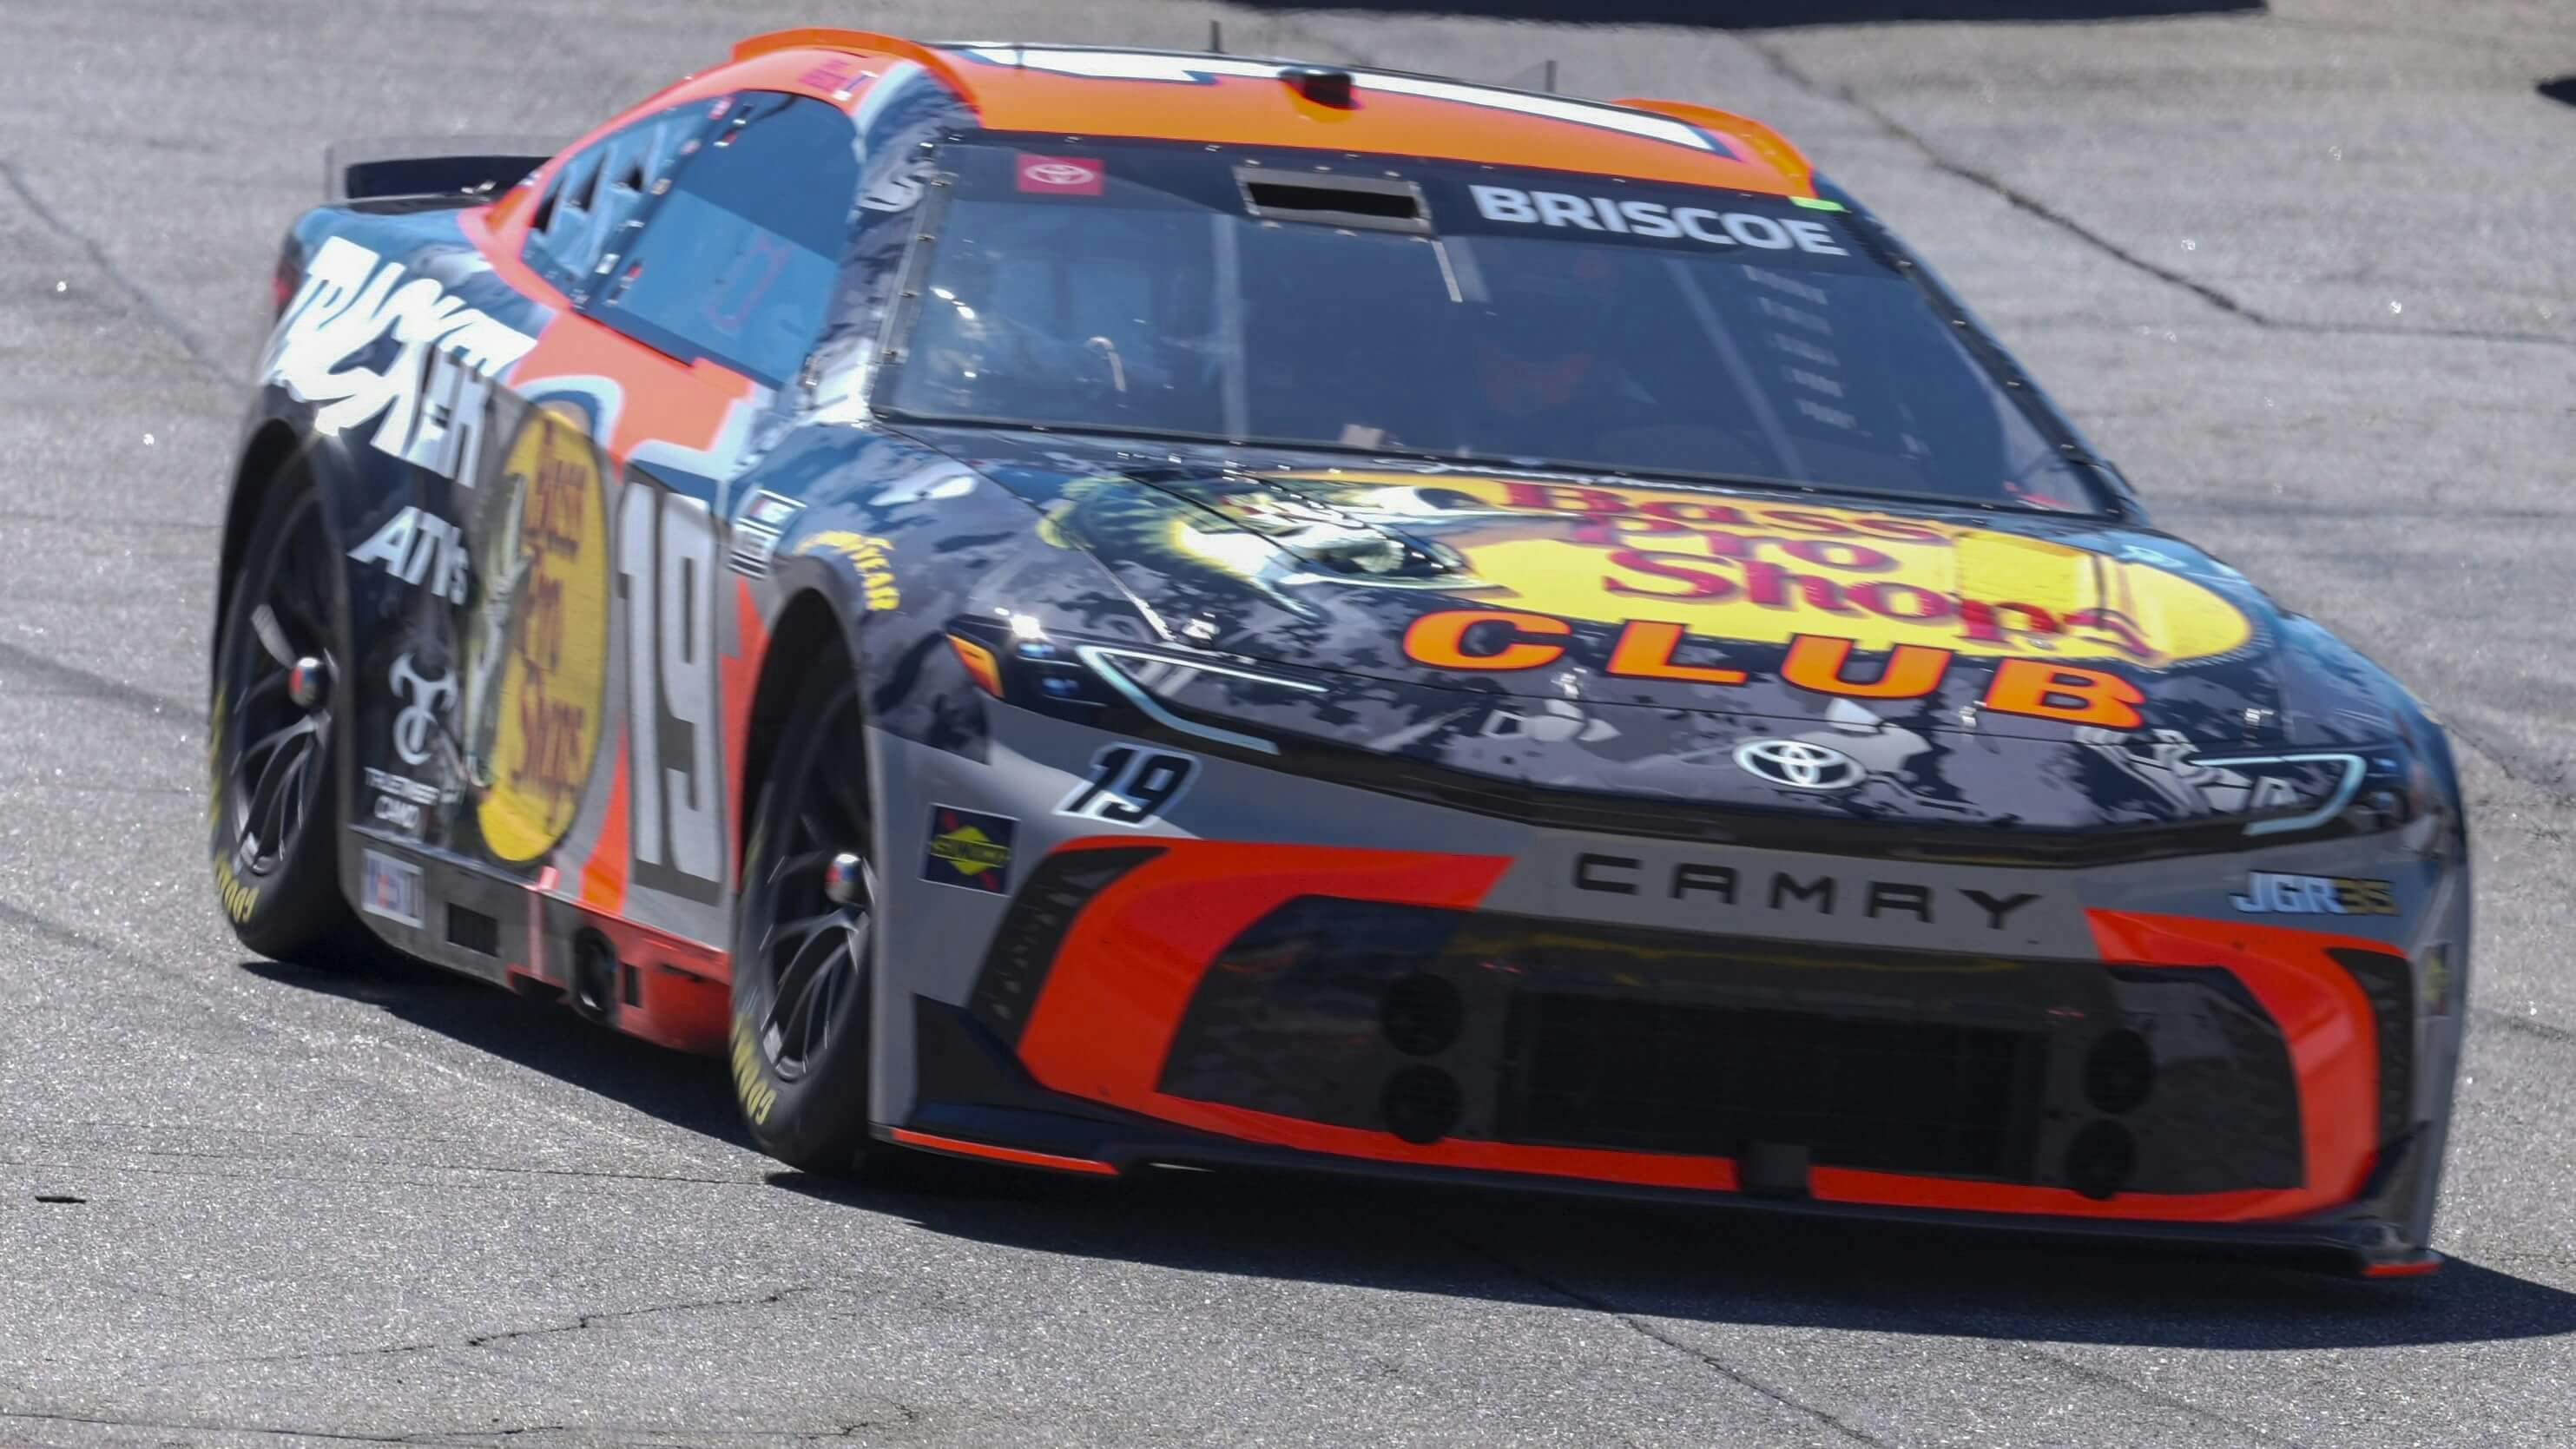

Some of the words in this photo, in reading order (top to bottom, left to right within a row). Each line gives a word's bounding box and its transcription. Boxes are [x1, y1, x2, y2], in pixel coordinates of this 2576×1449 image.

[1468, 184, 1851, 257] BRISCOE
[1490, 481, 1957, 546] Bass
[1567, 514, 1901, 573] Pro
[618, 481, 722, 882] 19
[1401, 609, 2147, 729] CLUB
[1056, 744, 1200, 827] 19
[1571, 852, 2045, 931] CAMRY
